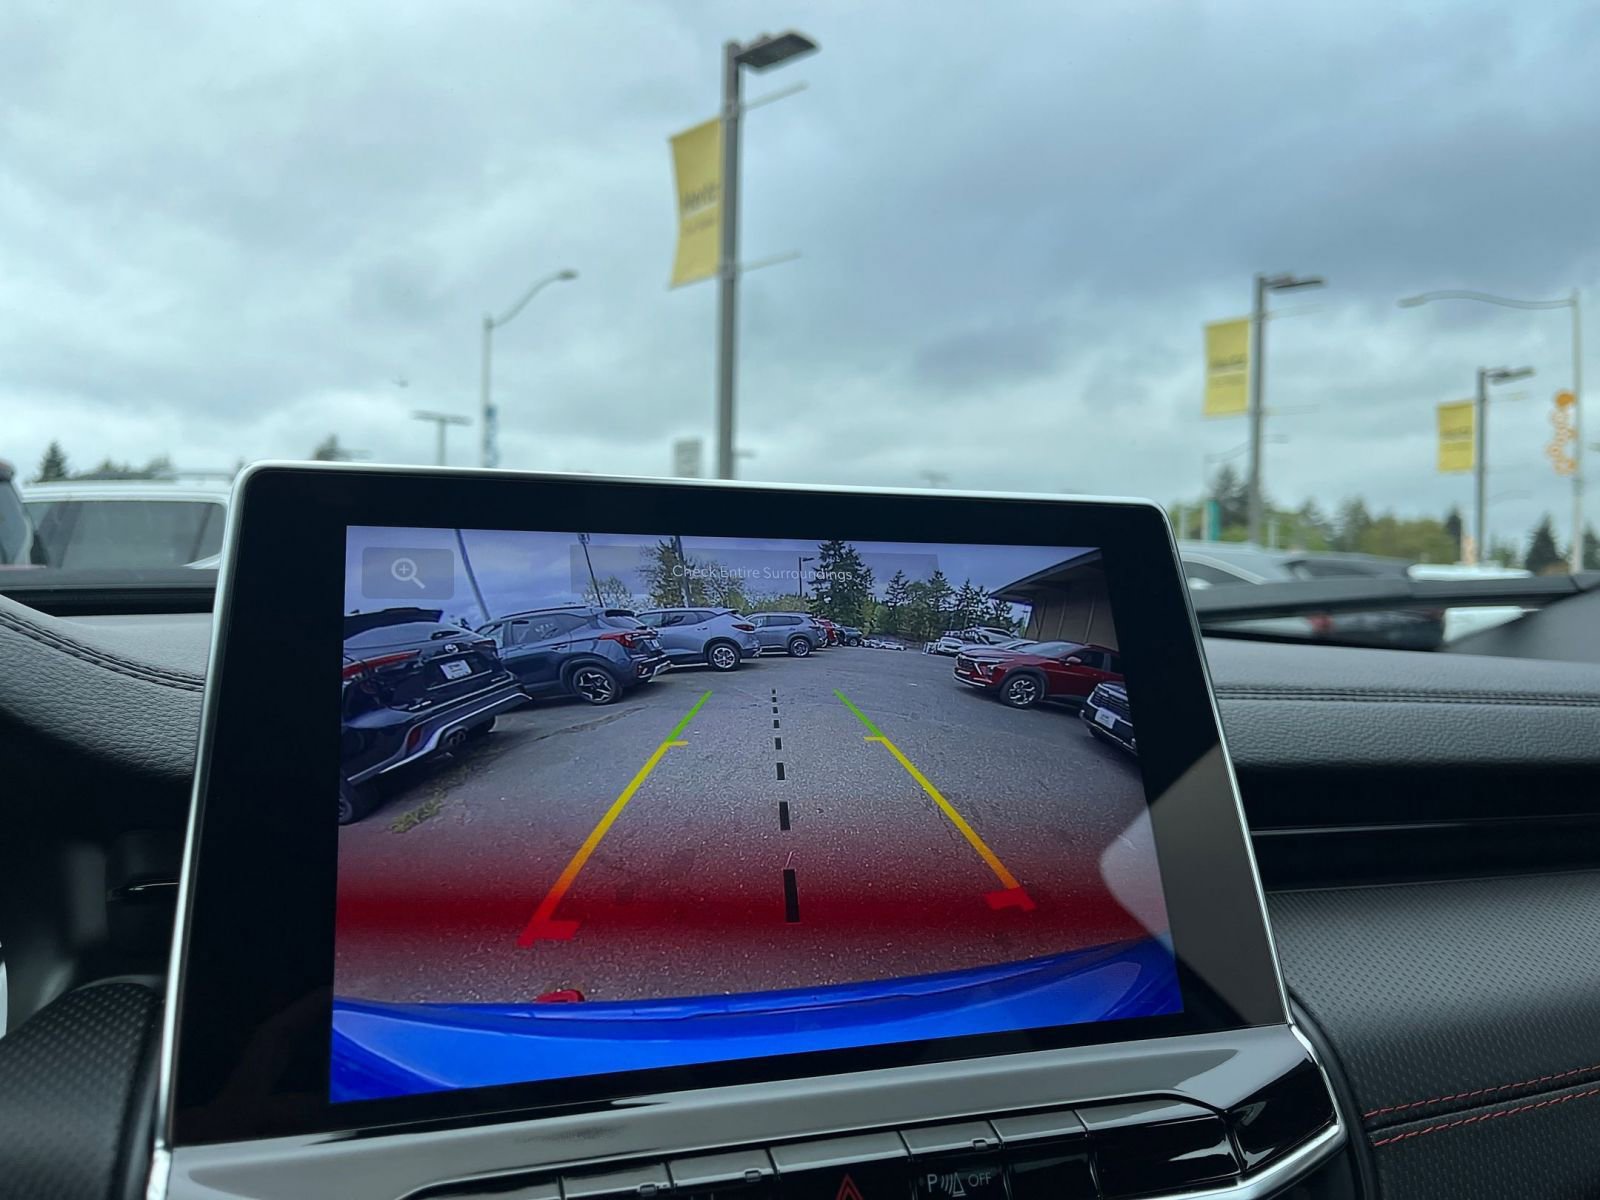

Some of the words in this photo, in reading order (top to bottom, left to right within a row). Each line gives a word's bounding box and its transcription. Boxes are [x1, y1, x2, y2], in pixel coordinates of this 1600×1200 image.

[672, 565, 715, 577] Check
[720, 567, 759, 579] Entire
[763, 567, 852, 582] Surroundings
[927, 1174, 938, 1192] P
[968, 1172, 991, 1187] OFF
